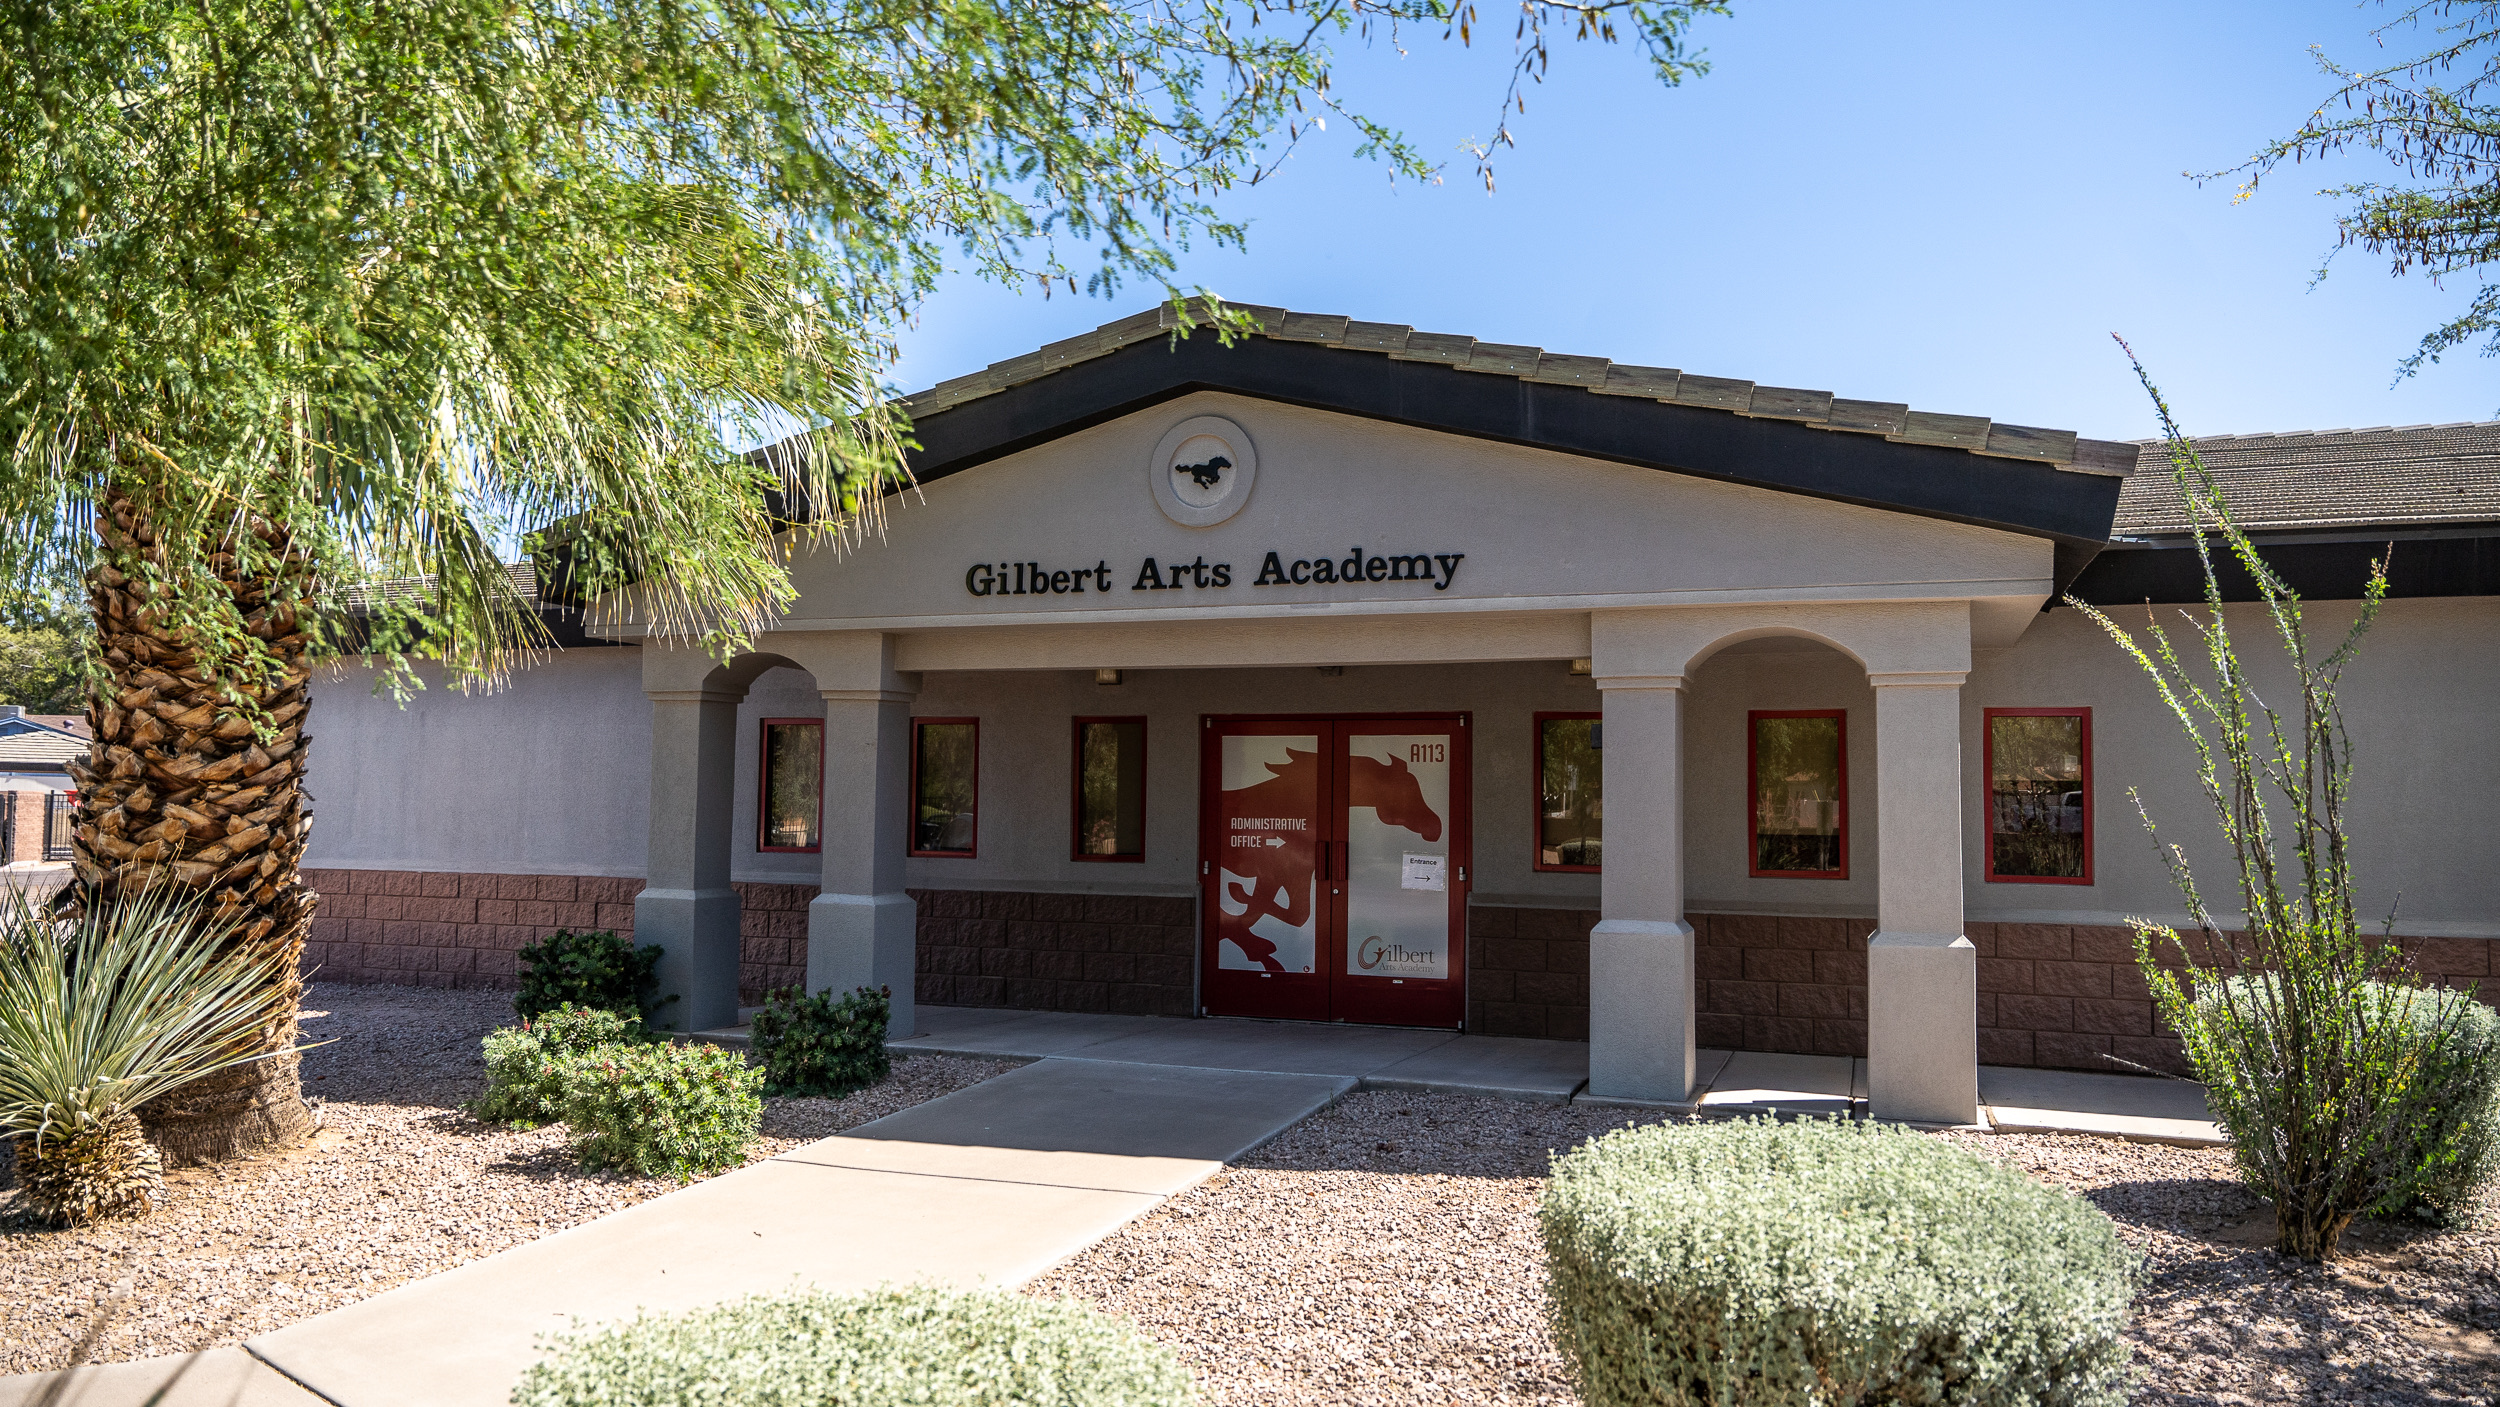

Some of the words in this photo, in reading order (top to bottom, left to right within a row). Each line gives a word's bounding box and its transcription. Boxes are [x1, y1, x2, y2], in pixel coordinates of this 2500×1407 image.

[965, 561, 1112, 597] Gilbert
[1132, 556, 1231, 590] Arts
[1253, 548, 1465, 591] Academy
[1410, 743, 1445, 763] A113
[1230, 817, 1307, 831] ADMINISTRATIVE
[1230, 835, 1262, 848] OFFICE
[1409, 857, 1438, 866] Entrance
[1357, 935, 1436, 970] Gilbert
[1379, 962, 1396, 971] Arts
[1397, 963, 1436, 975] Academy
